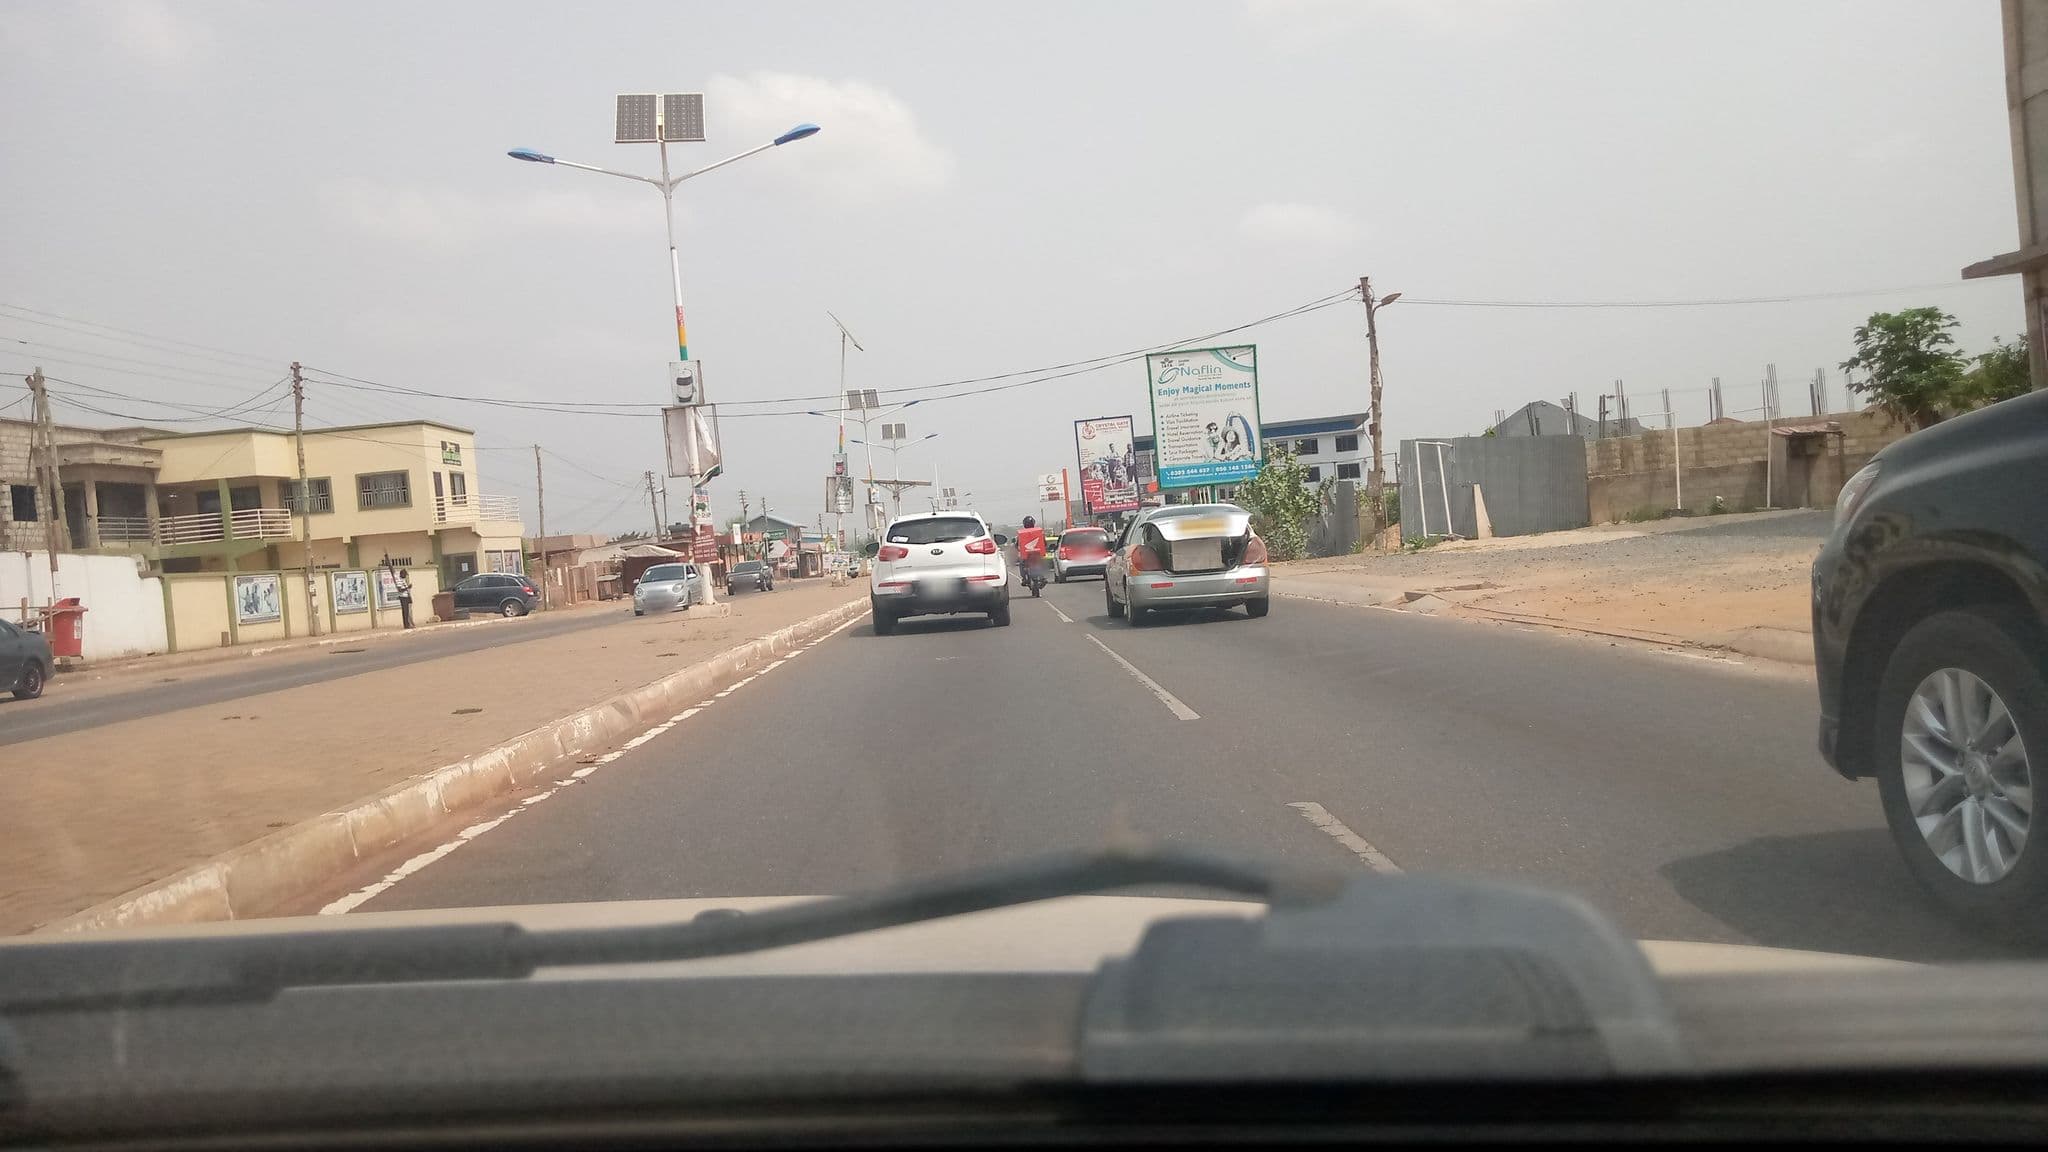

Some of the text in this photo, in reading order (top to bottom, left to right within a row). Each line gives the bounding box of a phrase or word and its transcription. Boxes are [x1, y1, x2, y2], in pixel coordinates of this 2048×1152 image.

[1180, 365, 1222, 377] Naflin
[1158, 388, 1180, 397] Enjoy
[1182, 384, 1212, 395] Magical
[1215, 381, 1251, 391] Moments
